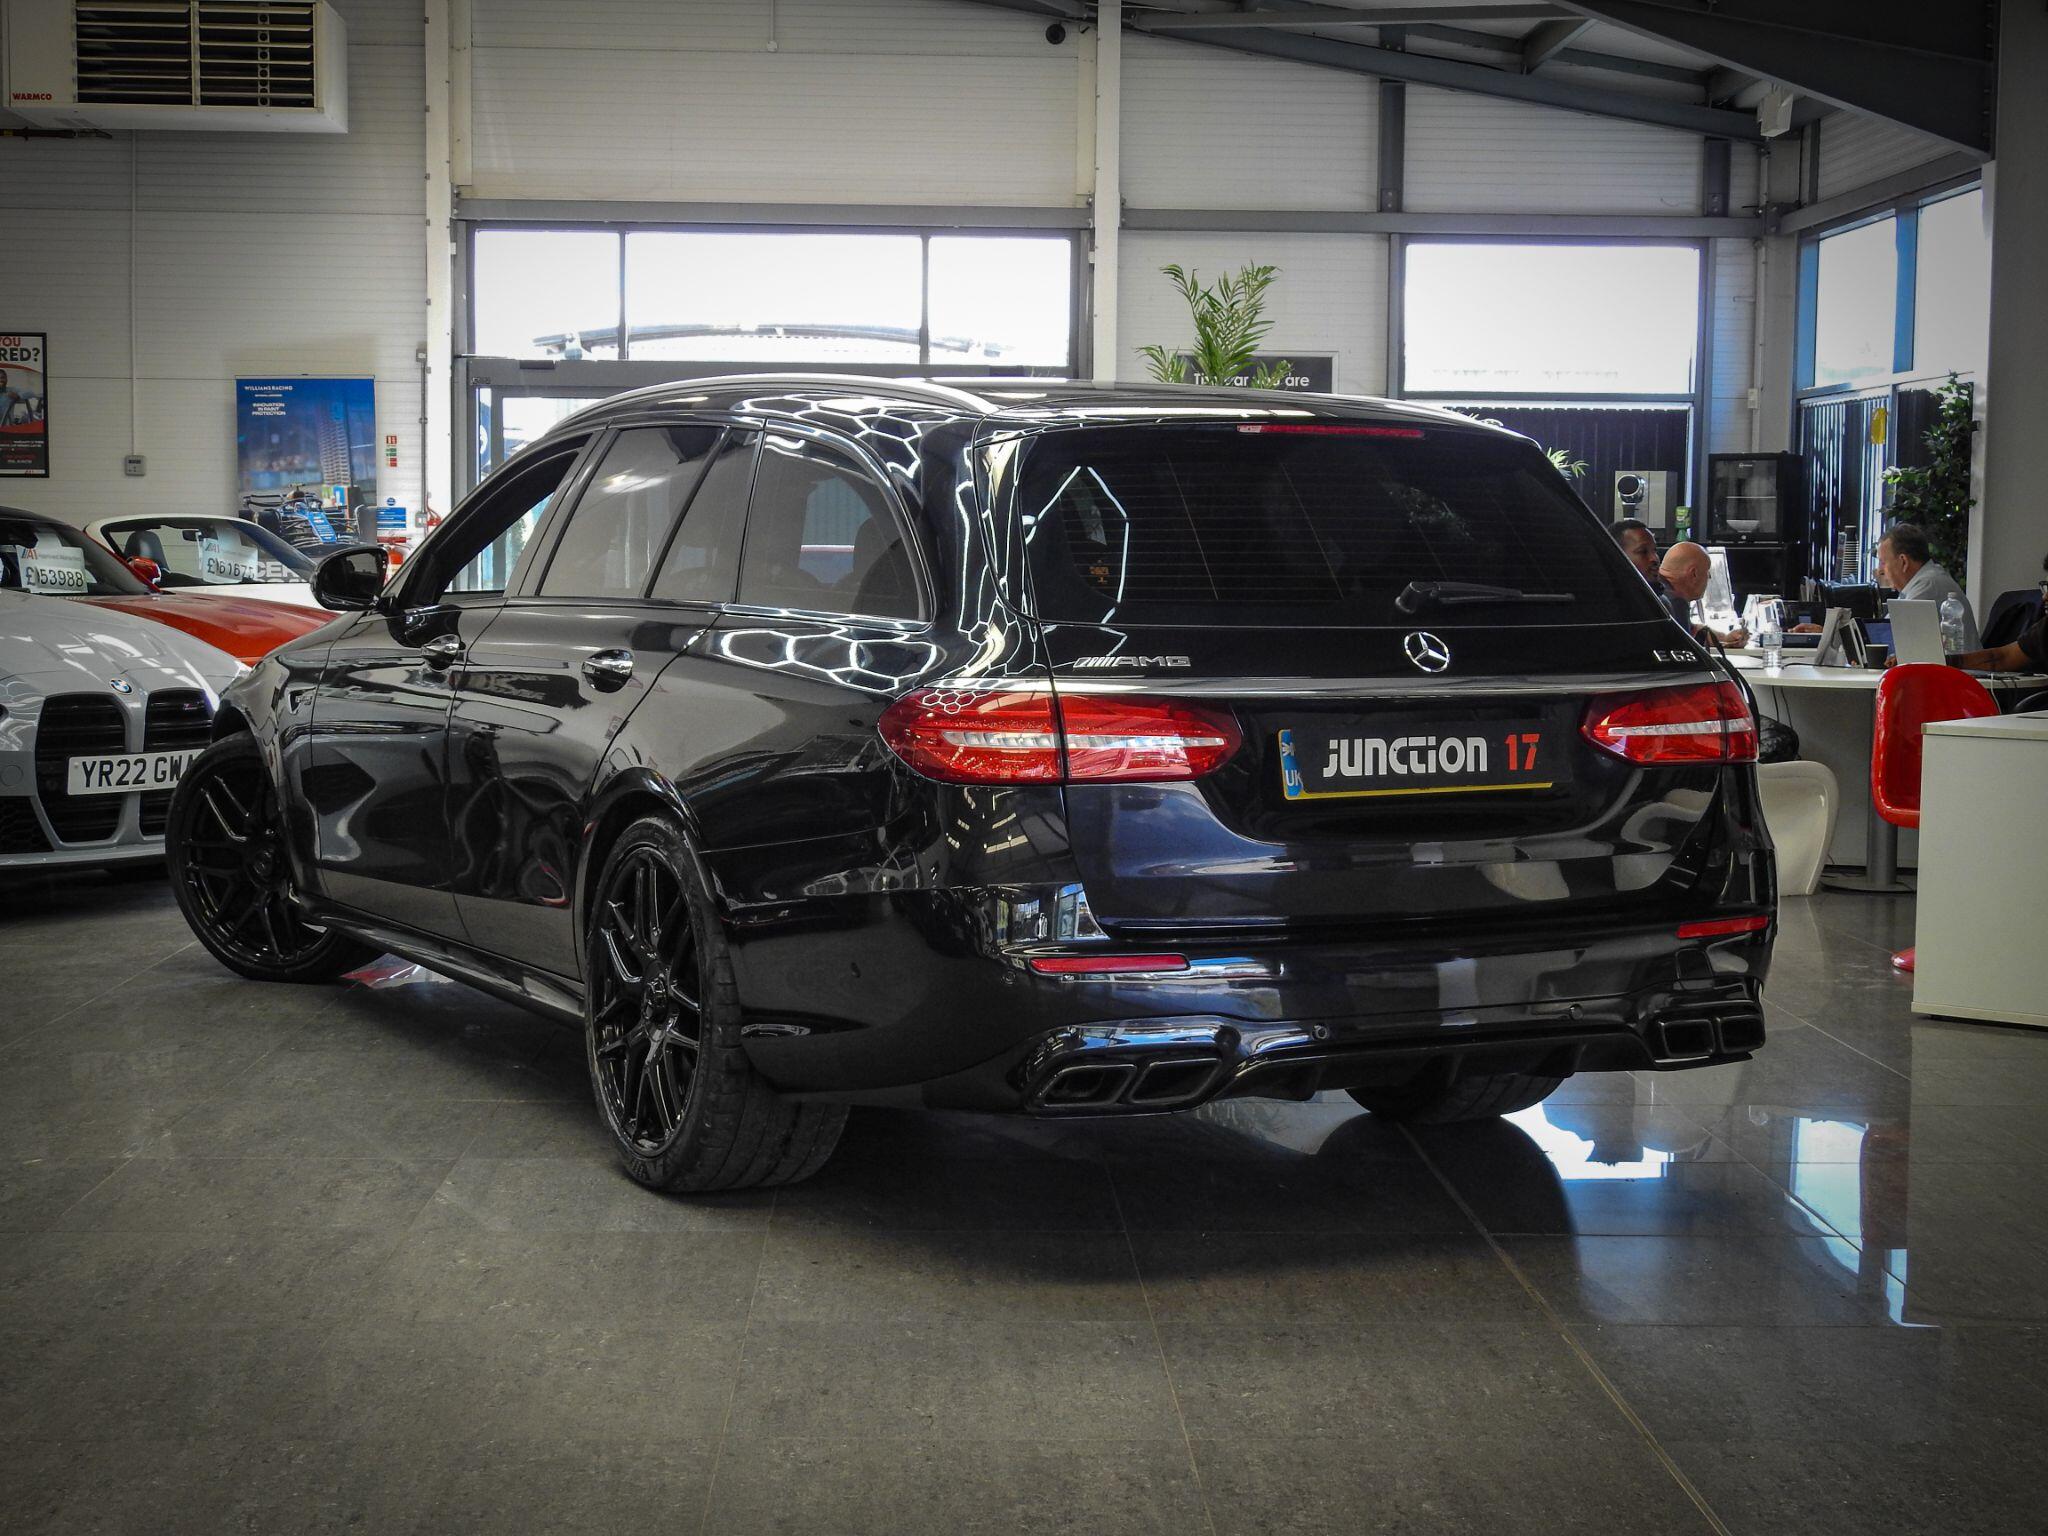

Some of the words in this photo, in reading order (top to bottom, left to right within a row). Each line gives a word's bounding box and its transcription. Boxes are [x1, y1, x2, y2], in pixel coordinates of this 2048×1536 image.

[12, 92, 52, 101] WARMCO
[1285, 375, 1310, 387] are
[1112, 655, 1192, 667] AMG
[1504, 733, 1540, 771] 17
[82, 758, 147, 788] YR22
[1285, 768, 1304, 787] UK
